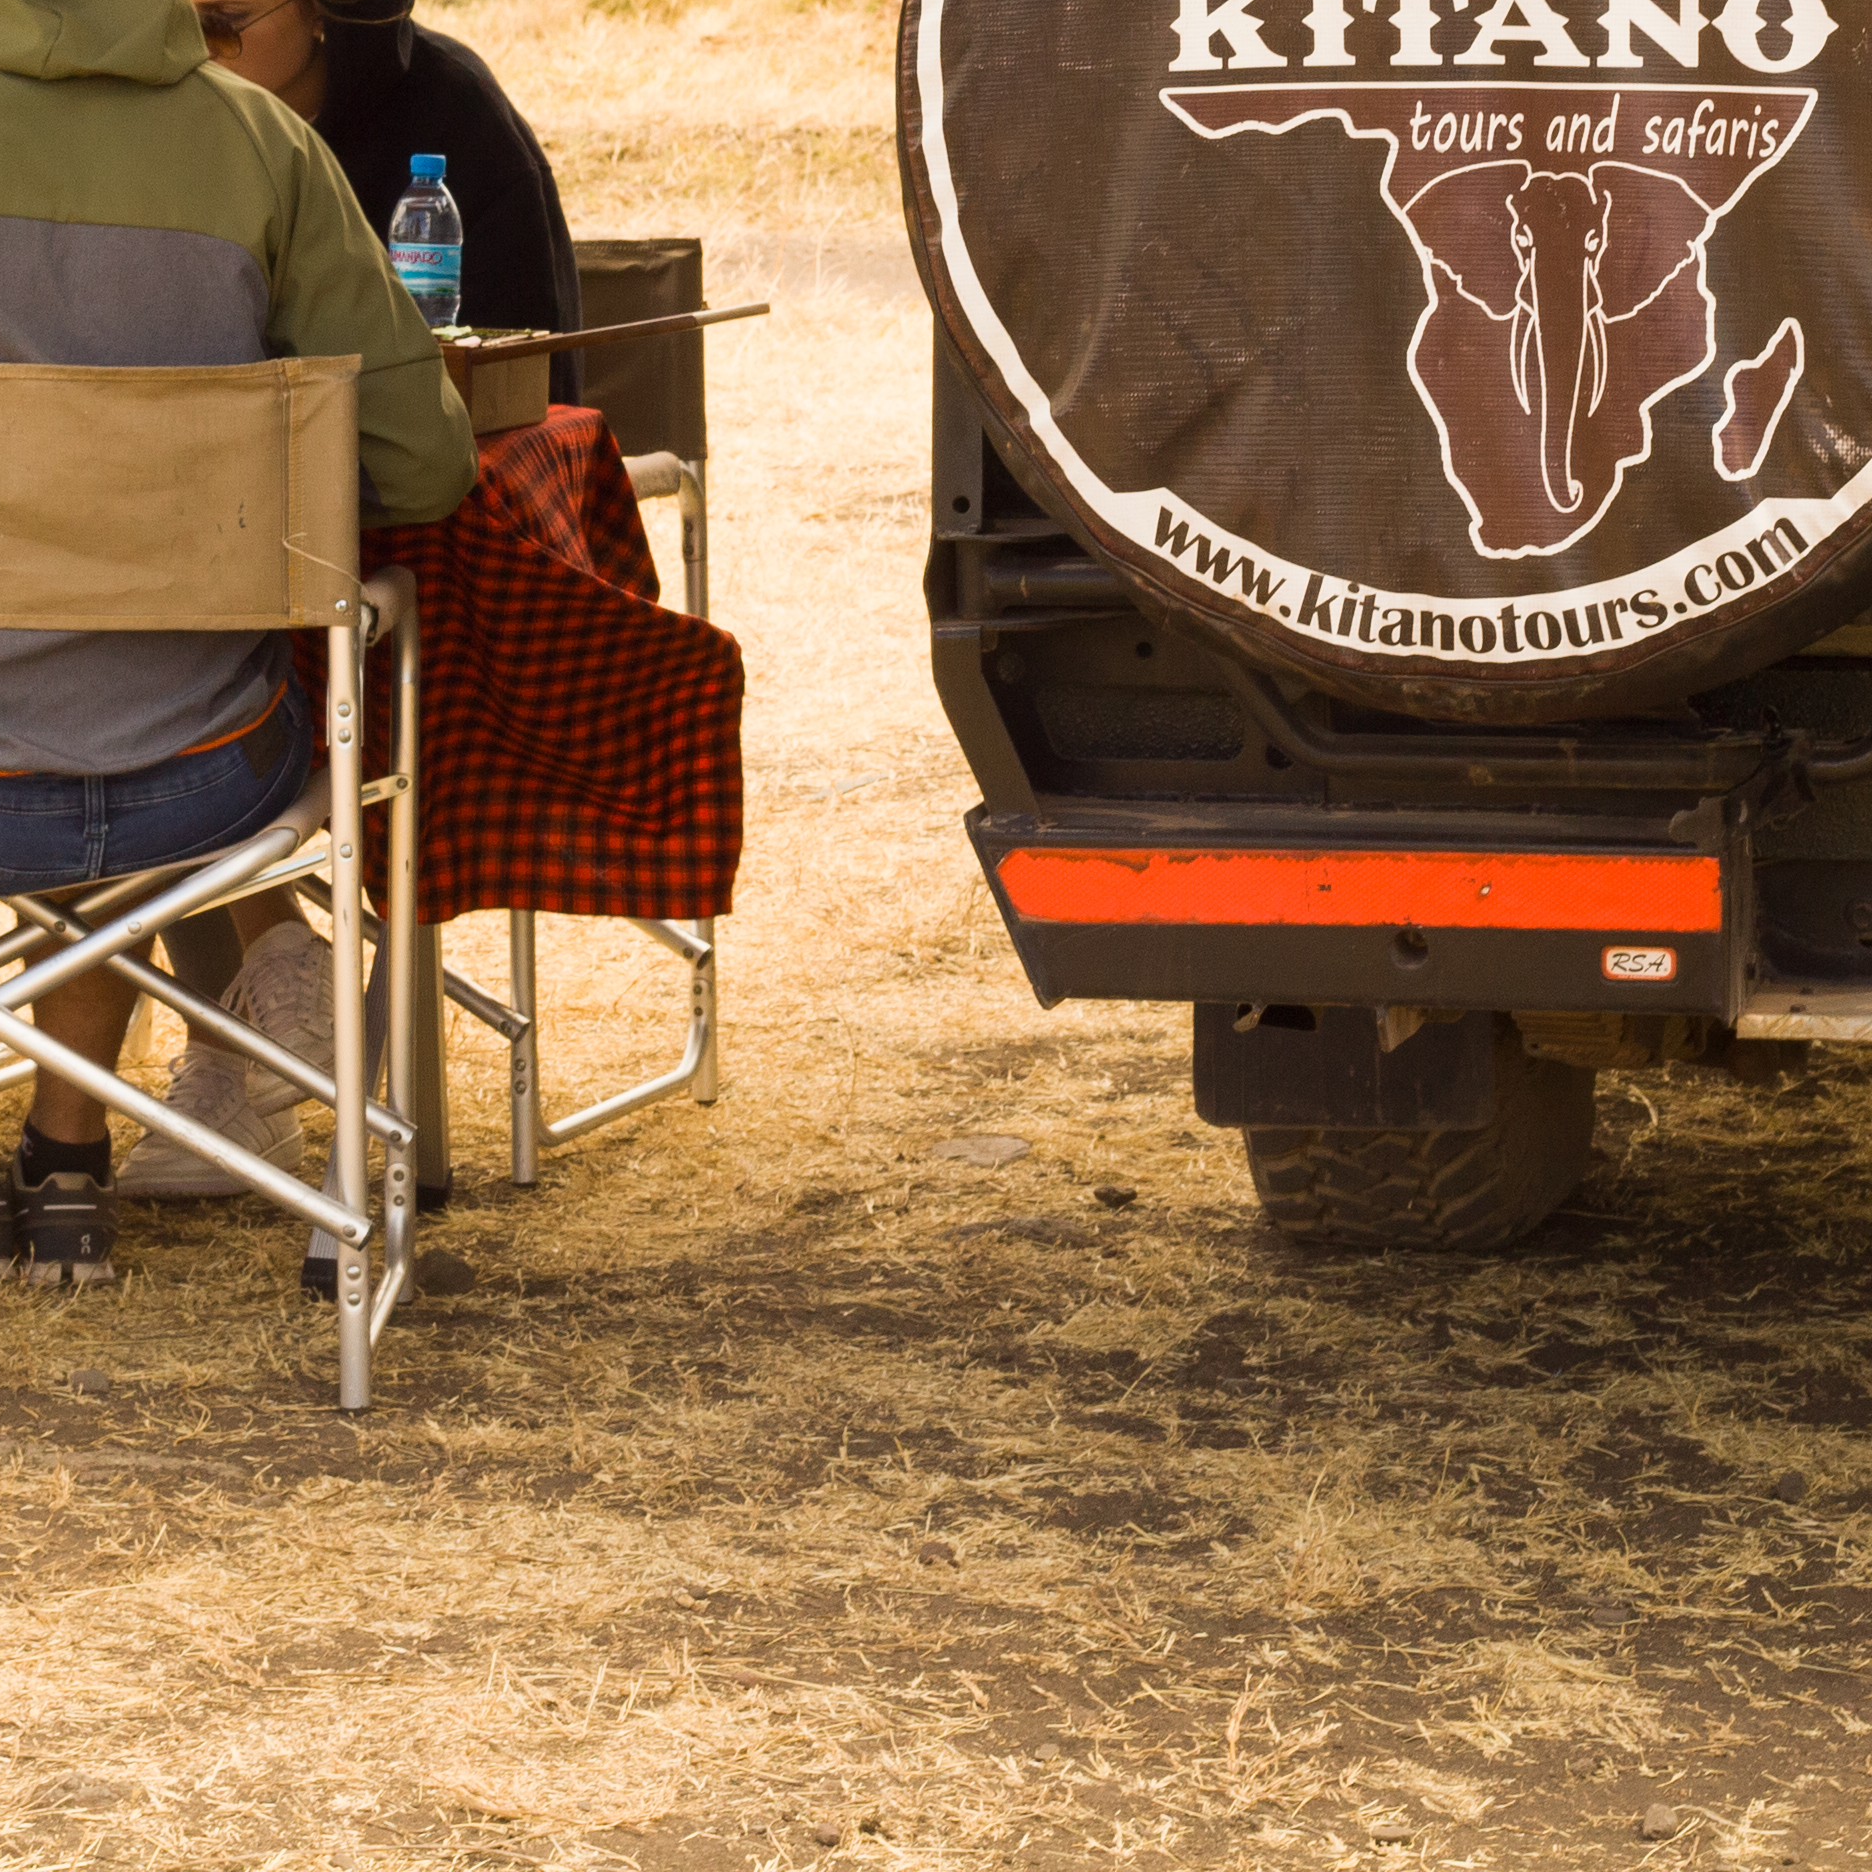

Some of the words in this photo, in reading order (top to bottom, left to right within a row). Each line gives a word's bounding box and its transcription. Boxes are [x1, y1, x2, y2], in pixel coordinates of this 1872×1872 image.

[1411, 100, 1524, 154] tours
[1546, 93, 1620, 154] and
[1642, 99, 1781, 160] safaris
[1155, 506, 1809, 654] www.kitanotours.com
[1610, 953, 1669, 974] RSA
